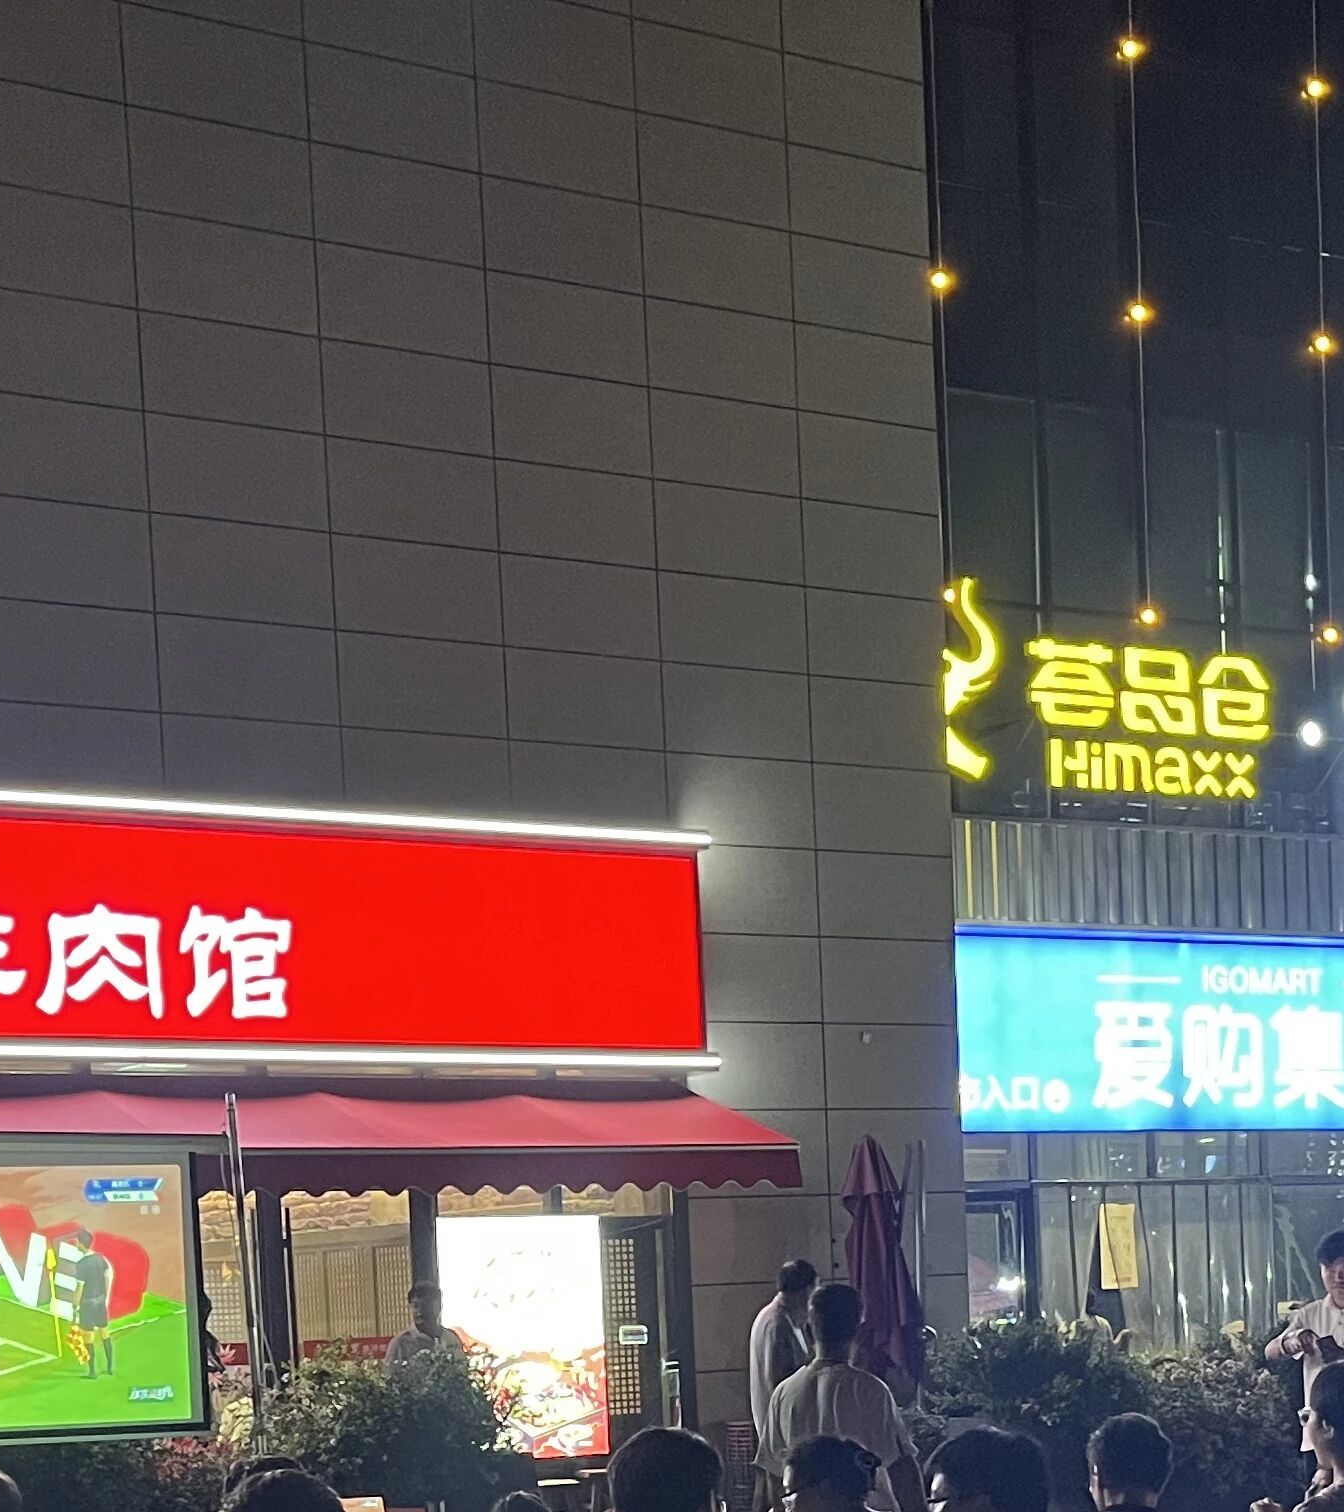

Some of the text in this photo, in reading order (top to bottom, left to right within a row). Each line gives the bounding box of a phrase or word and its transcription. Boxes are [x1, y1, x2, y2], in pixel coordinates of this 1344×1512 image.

[1027, 640, 1270, 740] 荟品仓
[1049, 737, 1256, 798] Himaxx
[1201, 964, 1323, 995] IGOMART
